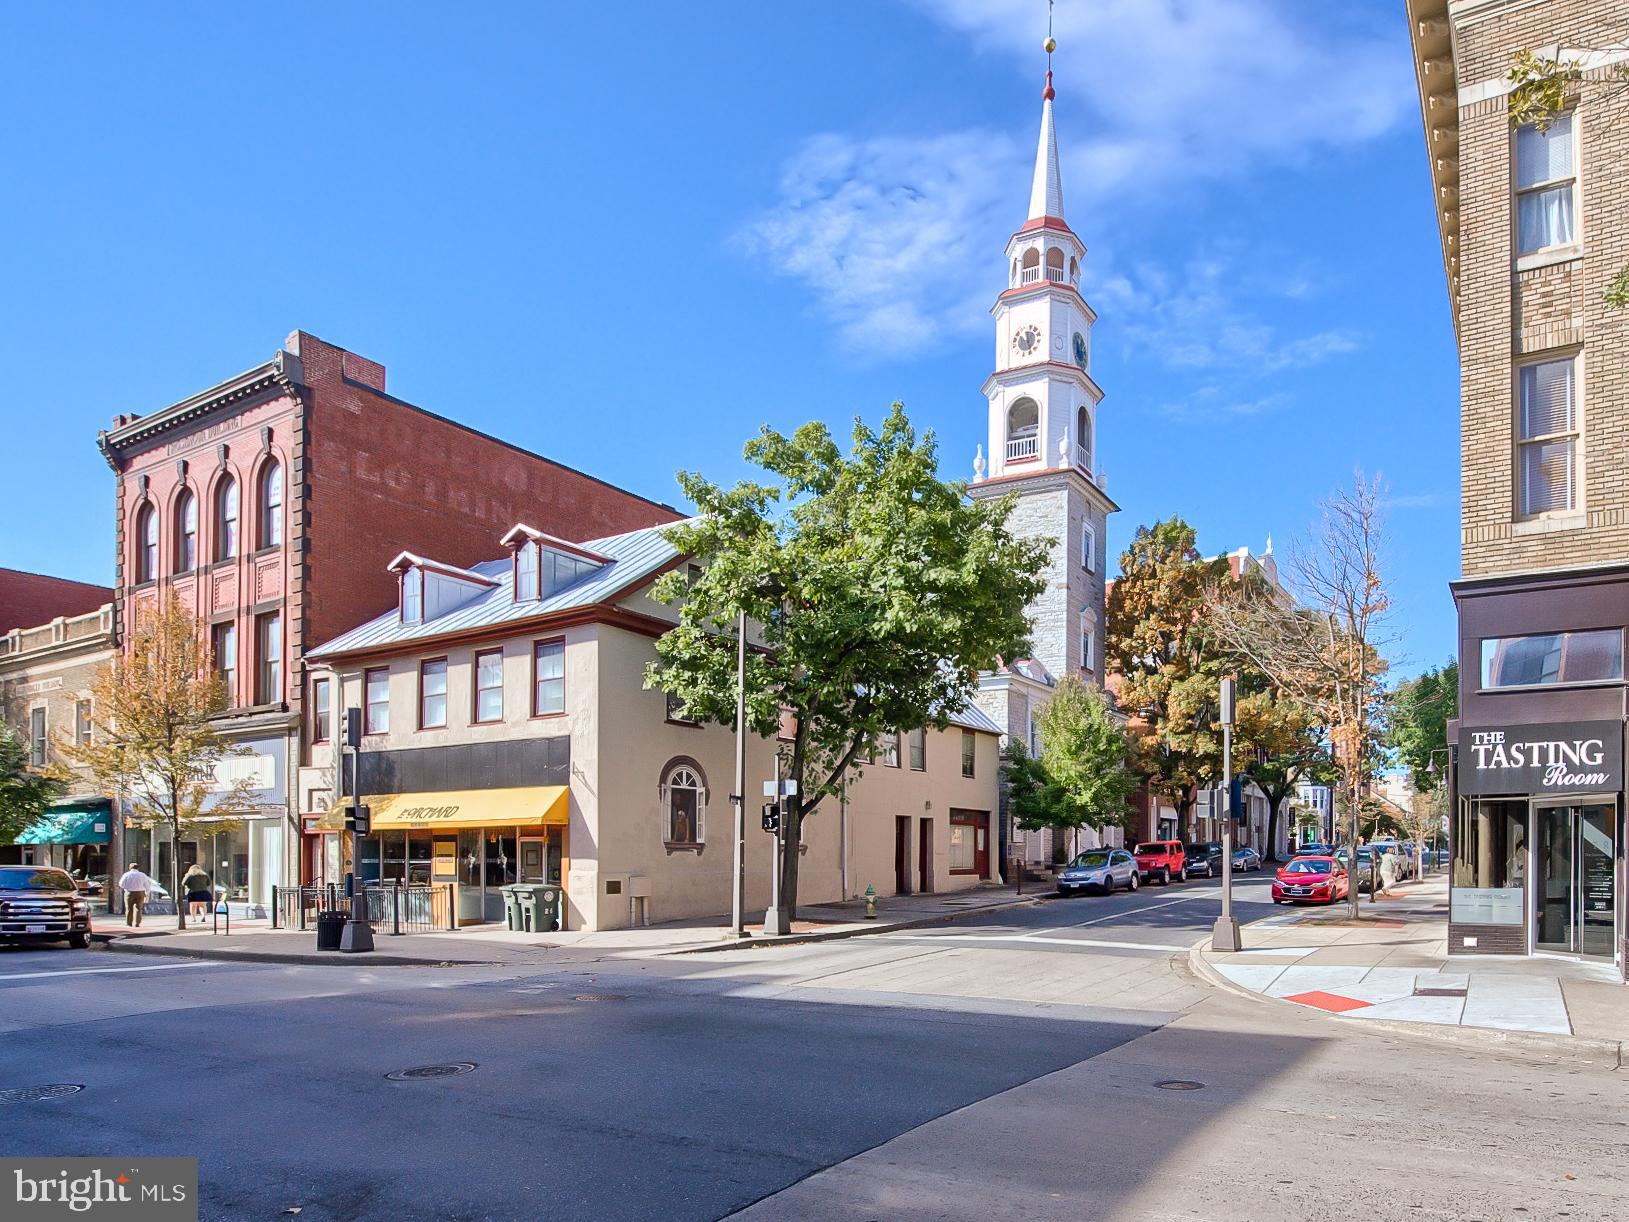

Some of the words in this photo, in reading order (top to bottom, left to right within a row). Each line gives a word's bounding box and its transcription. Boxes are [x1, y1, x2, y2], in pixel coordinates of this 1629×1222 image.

[1472, 731, 1506, 744] THE
[1471, 739, 1604, 769] TASTING
[1543, 764, 1610, 786] Room
